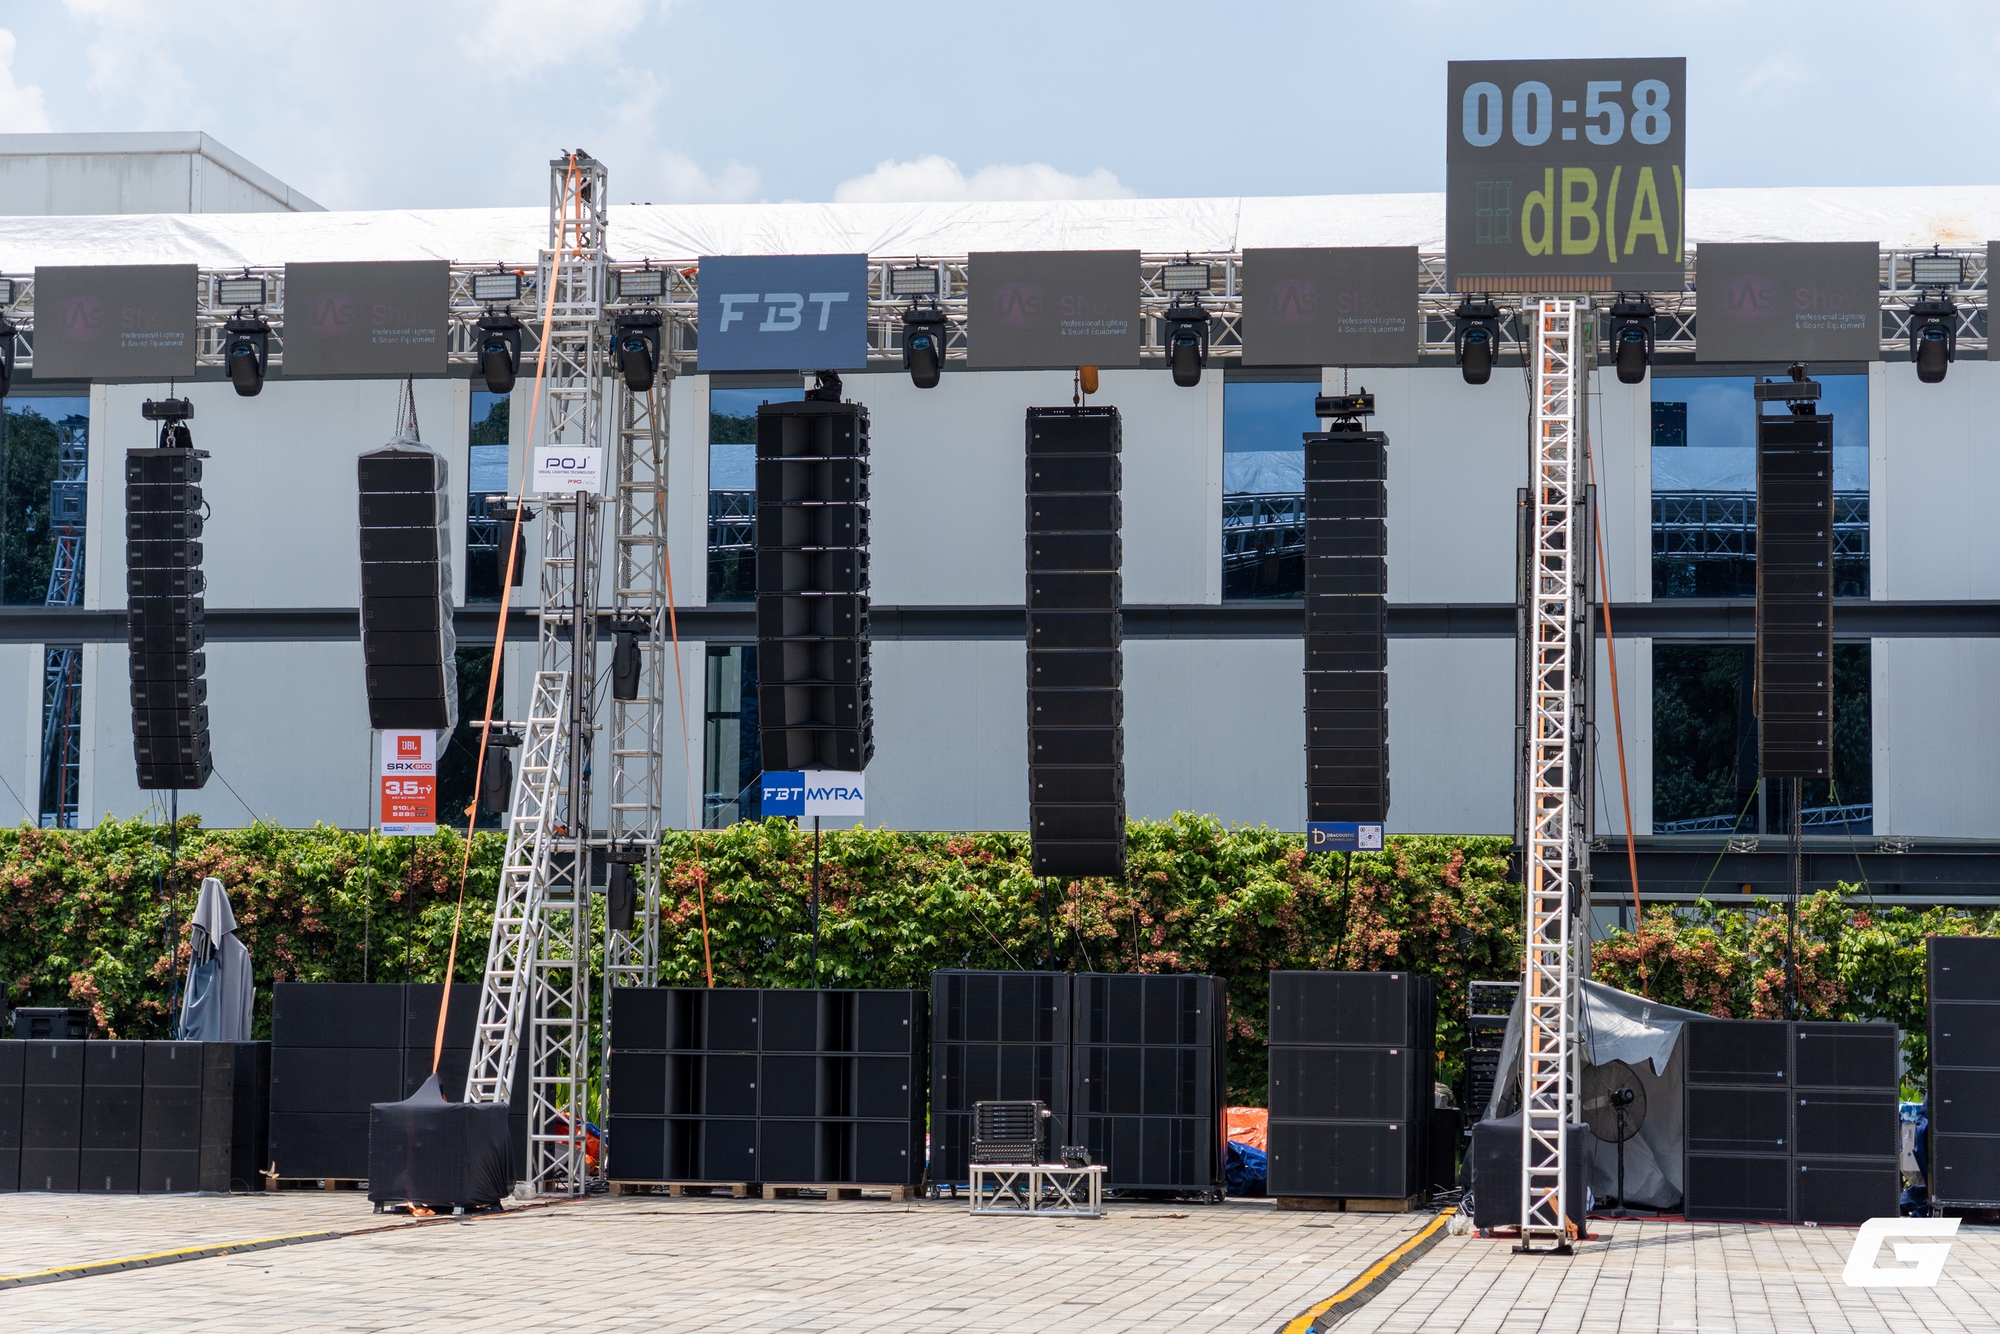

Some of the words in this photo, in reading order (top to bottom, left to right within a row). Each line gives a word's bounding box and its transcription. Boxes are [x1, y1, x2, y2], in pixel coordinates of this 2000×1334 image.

[1462, 79, 1672, 147] 00:58
[1521, 165, 1683, 263] dB(A)
[719, 292, 850, 332] FBT
[1379, 317, 1406, 326] Lighting
[1838, 313, 1866, 322] Lighting
[1061, 319, 1101, 327] Professional
[1102, 319, 1128, 328] Lighting
[1827, 322, 1865, 330] Equipment
[411, 328, 436, 336] Lighting
[1091, 328, 1127, 337] Equipment
[1368, 326, 1405, 334] Equipment
[159, 332, 185, 340] Lighting
[401, 336, 435, 344] Equipment
[149, 340, 183, 348] Equipment
[546, 458, 586, 469] POJ
[402, 741, 417, 750] JBL
[763, 787, 804, 801] FBT
[806, 787, 864, 800] MYRA
